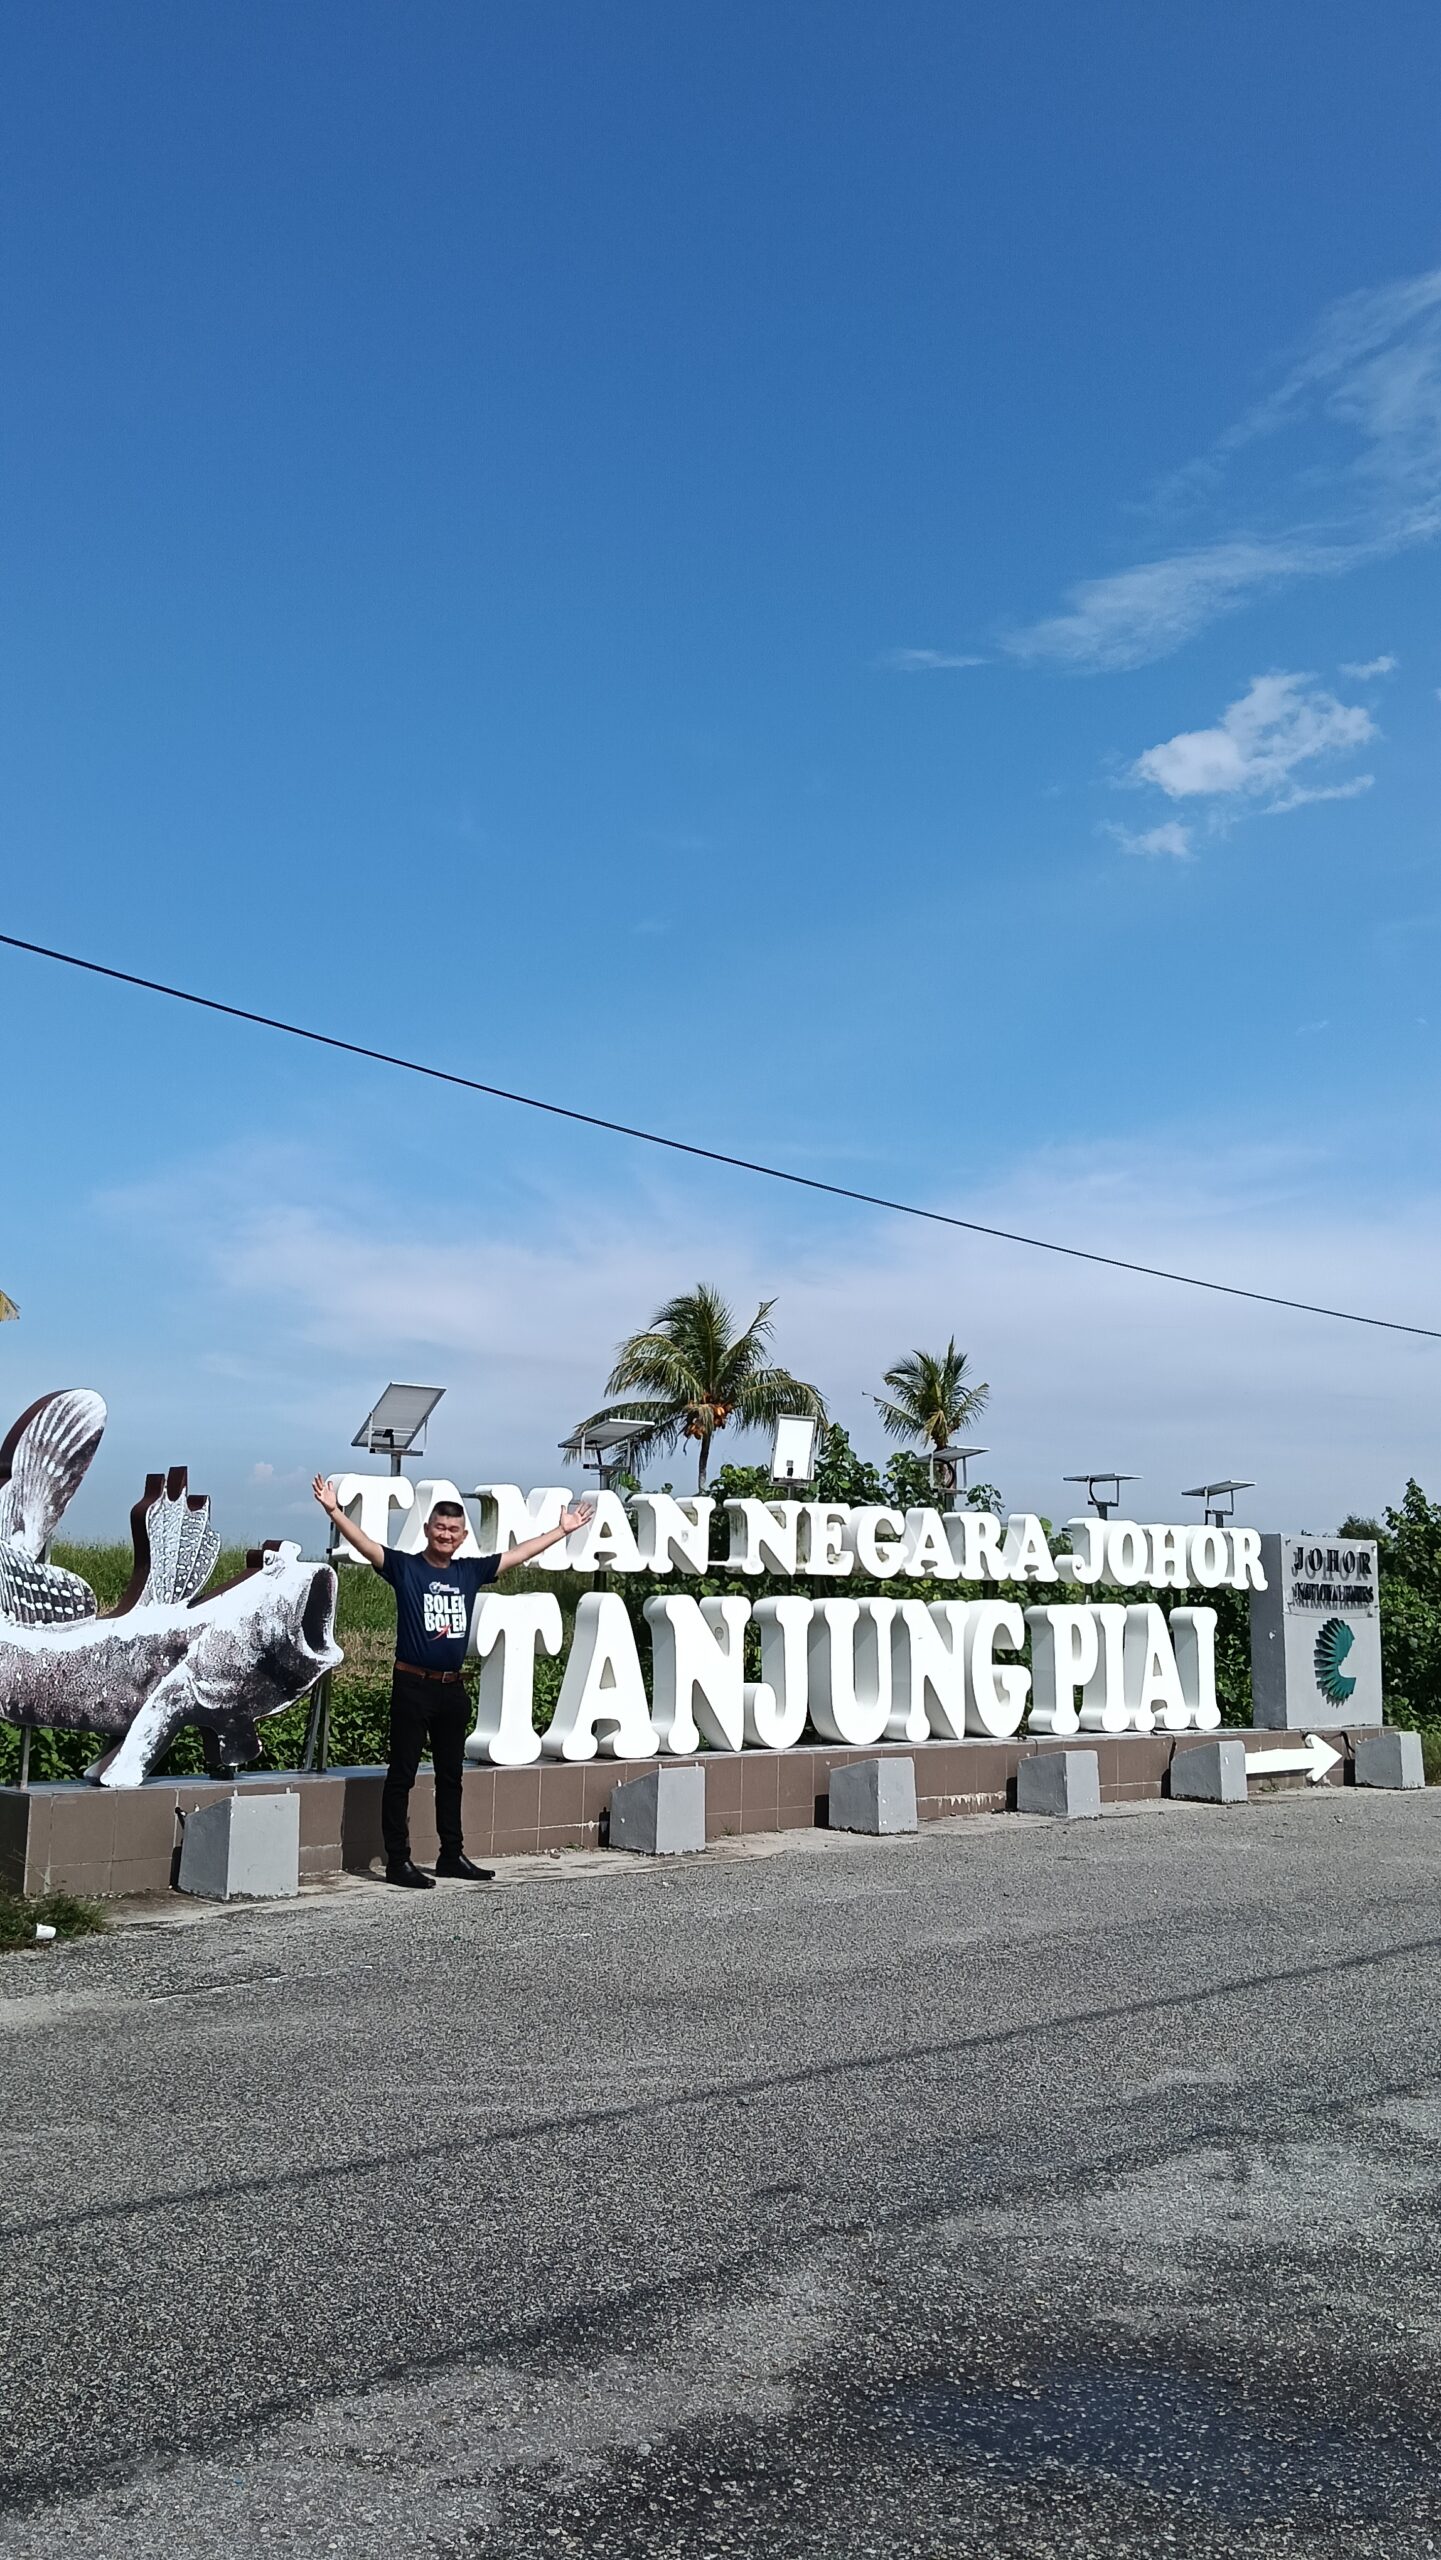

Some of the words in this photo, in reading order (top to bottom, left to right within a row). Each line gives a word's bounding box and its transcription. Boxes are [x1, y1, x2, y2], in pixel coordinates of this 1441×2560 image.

[327, 1473, 716, 1575] TAMAN
[723, 1498, 1059, 1582] NEGARA
[1055, 1517, 1268, 1591] JOHOR
[1293, 1546, 1373, 1575] JOHOR
[466, 1591, 1032, 1766] TANJUNG
[1024, 1603, 1221, 1736] PIAI
